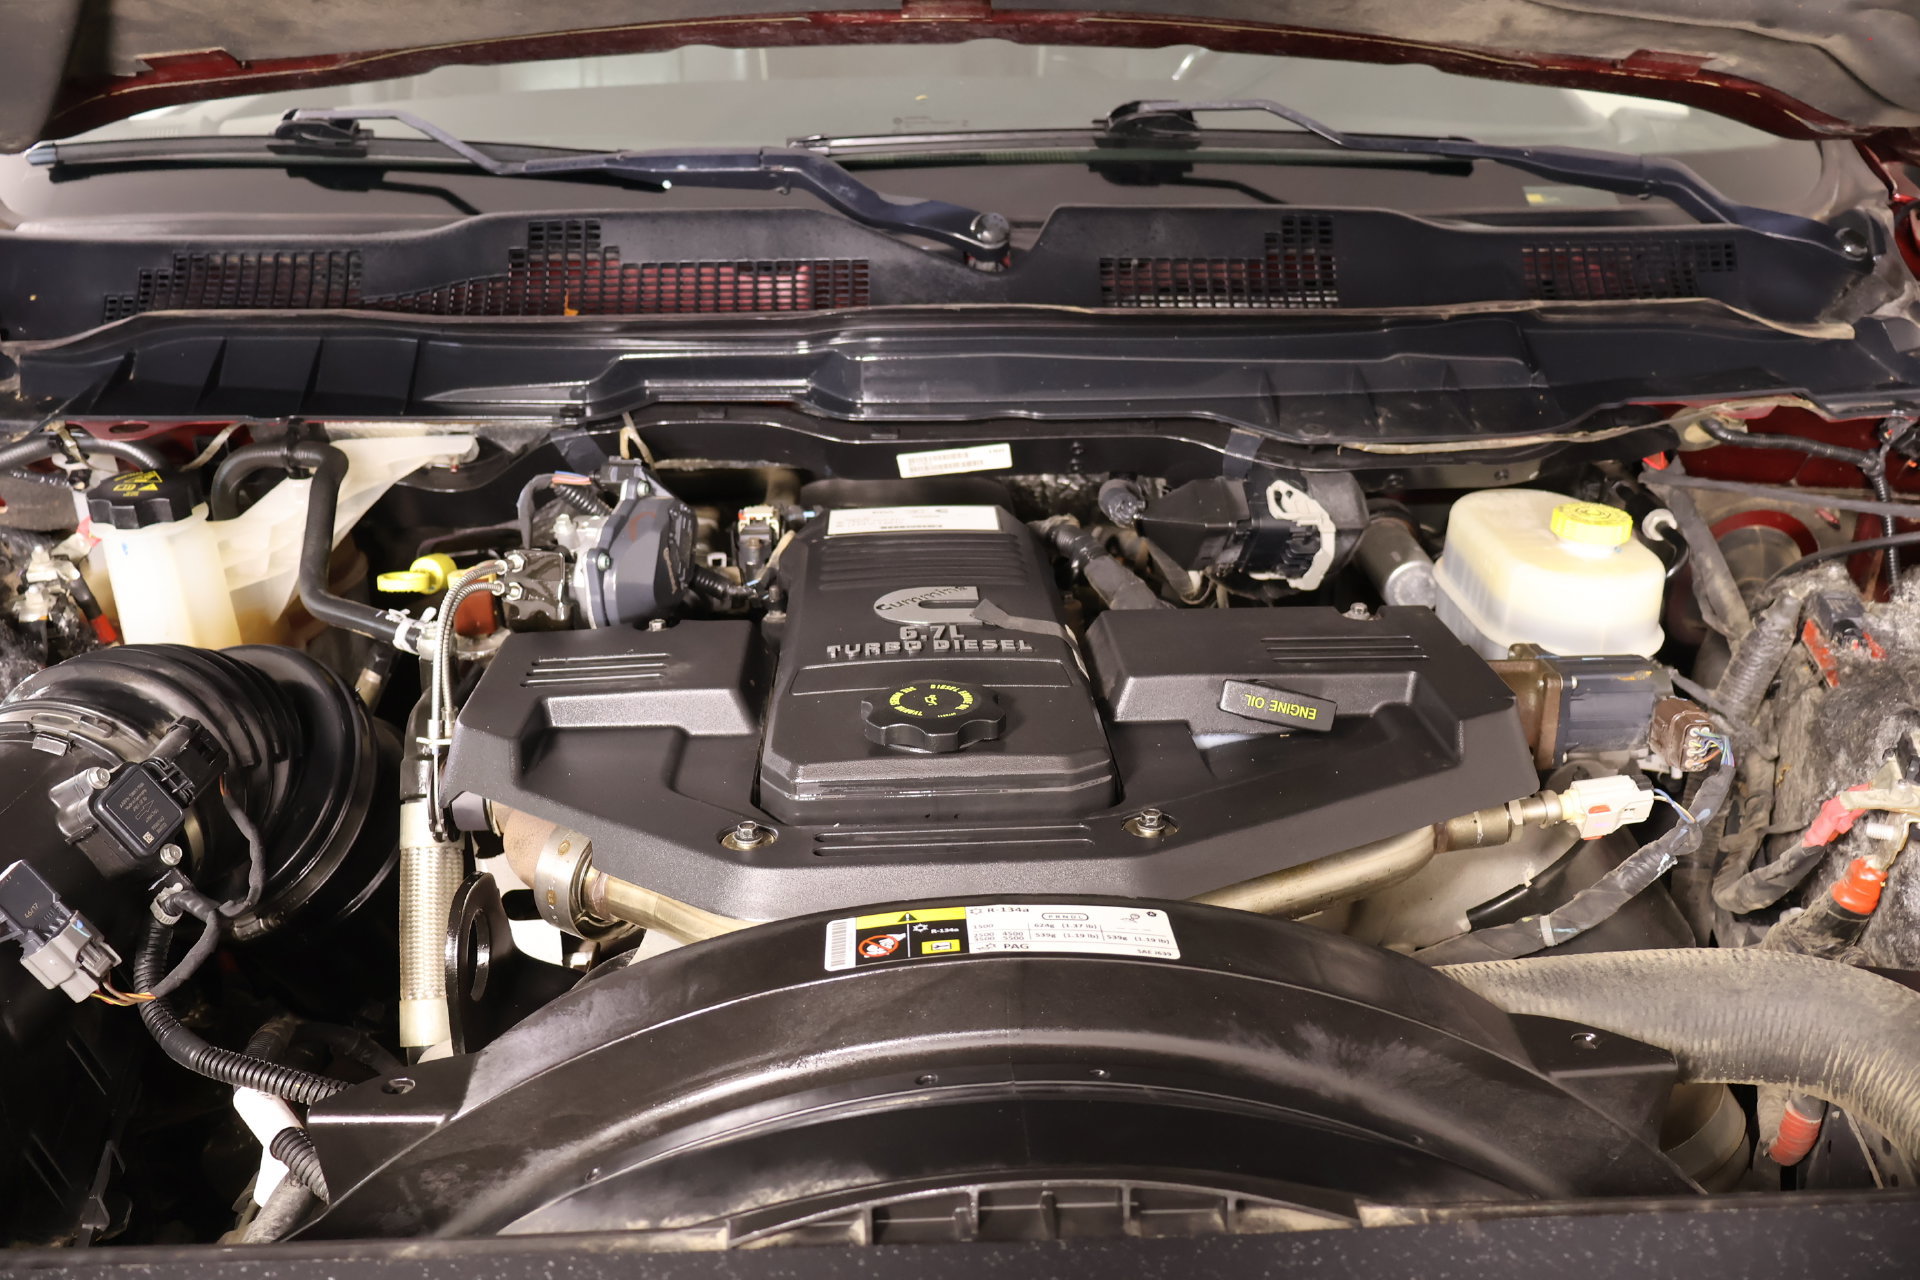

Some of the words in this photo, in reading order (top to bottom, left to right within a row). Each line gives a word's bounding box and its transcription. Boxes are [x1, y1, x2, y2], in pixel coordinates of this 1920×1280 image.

[876, 586, 967, 611] Cummins
[900, 625, 965, 641] 6.7L
[826, 640, 922, 658] TURBO
[933, 639, 1033, 653] DIESEL
[1244, 694, 1265, 709] OIL
[1269, 700, 1317, 720] ENGINE
[24, 902, 39, 918] 46/17
